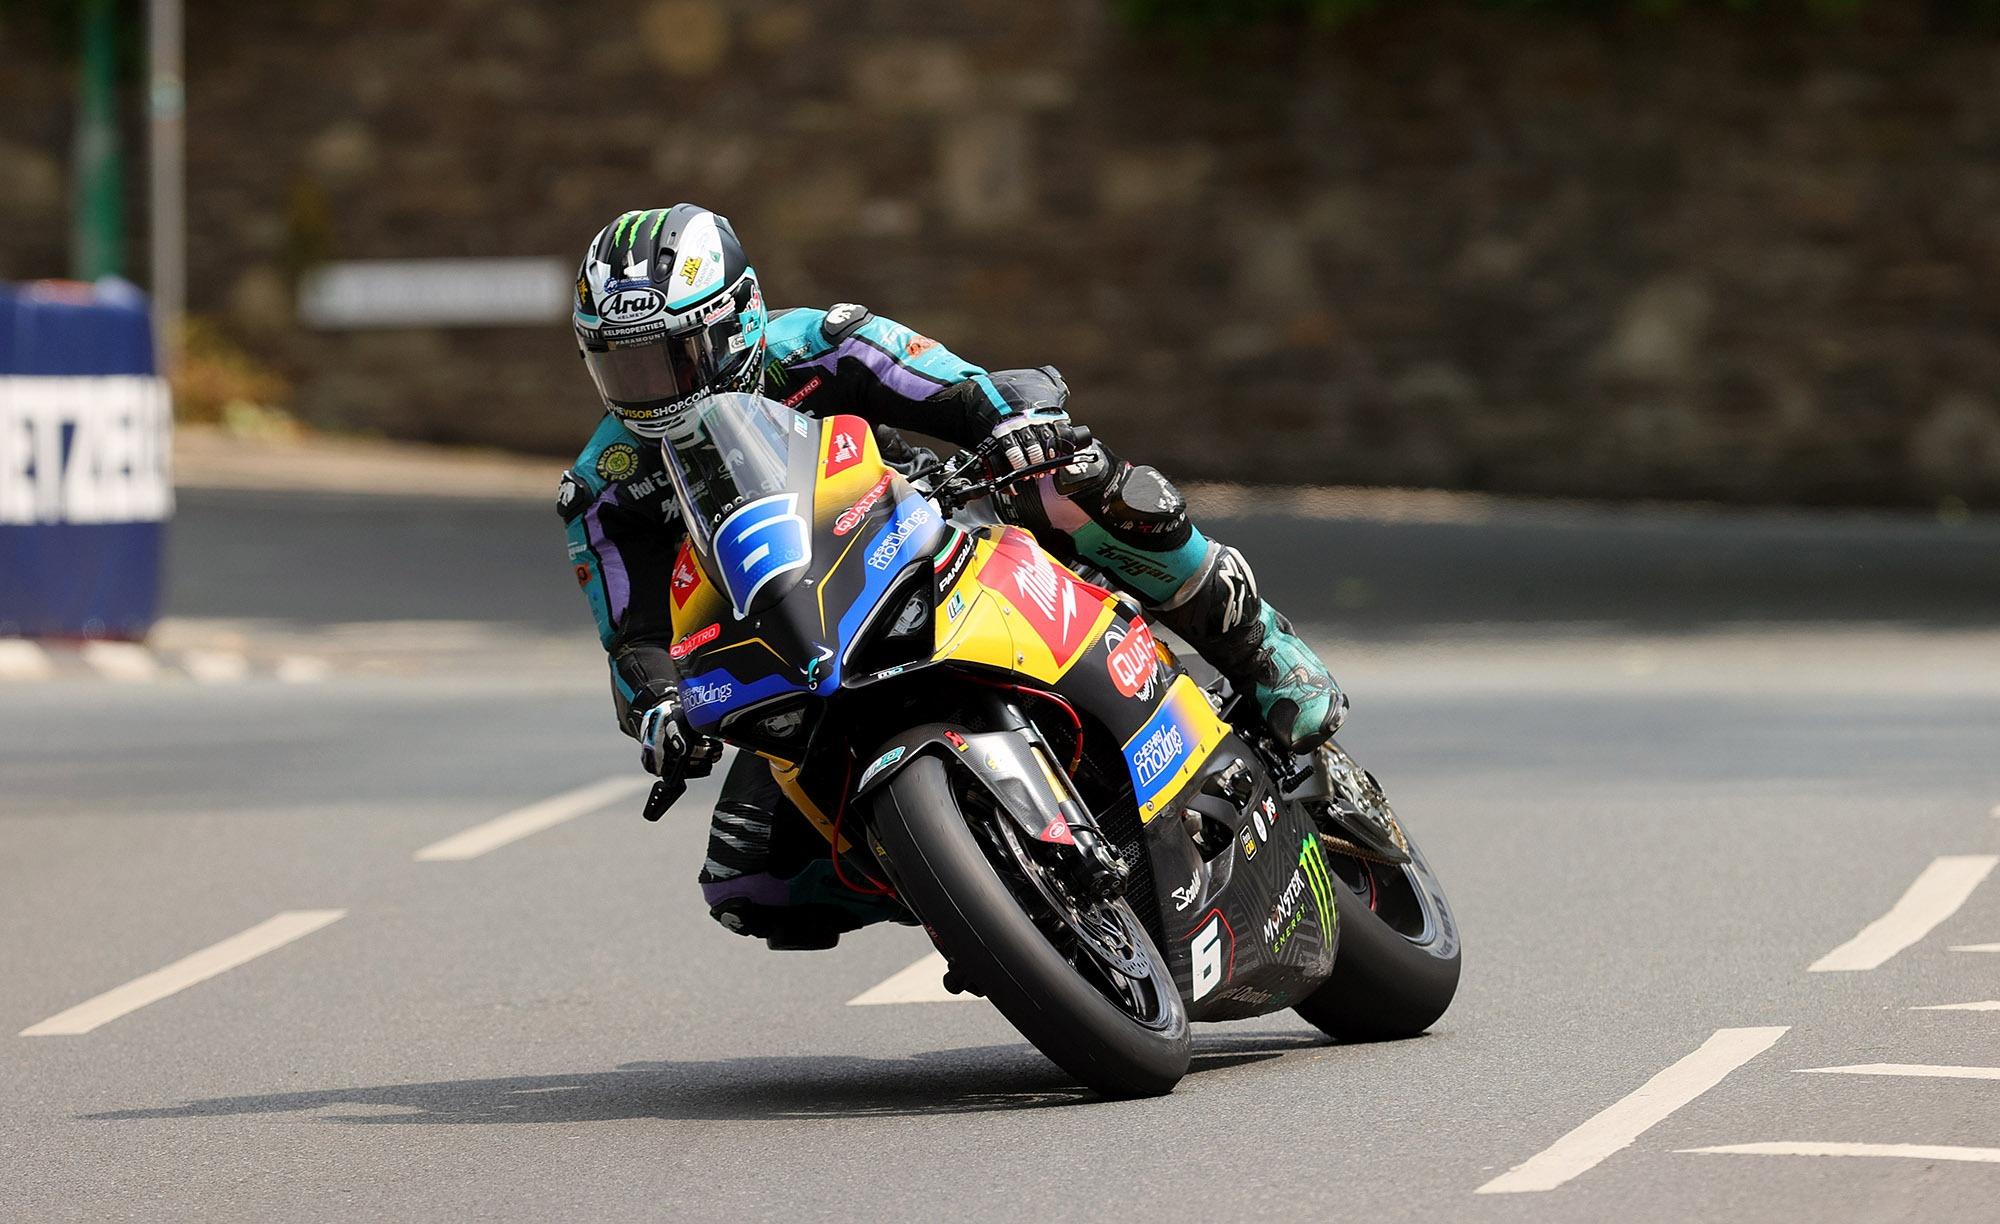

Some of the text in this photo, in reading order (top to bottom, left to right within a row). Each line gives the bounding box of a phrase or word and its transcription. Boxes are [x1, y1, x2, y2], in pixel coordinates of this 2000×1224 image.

[602, 292, 656, 318] Arai
[604, 321, 665, 336] KELPROPERTIES
[616, 332, 666, 345] PARAMOUNT
[786, 378, 820, 407] ATTRO
[837, 474, 891, 532] QUATTRO
[873, 507, 930, 571] mouldings
[671, 627, 716, 656] QUATTRO
[1136, 724, 1183, 785] mouldings
[1263, 868, 1305, 944] MONSTER
[1273, 902, 1306, 954] ENERGY
[1191, 916, 1221, 1002] 6
